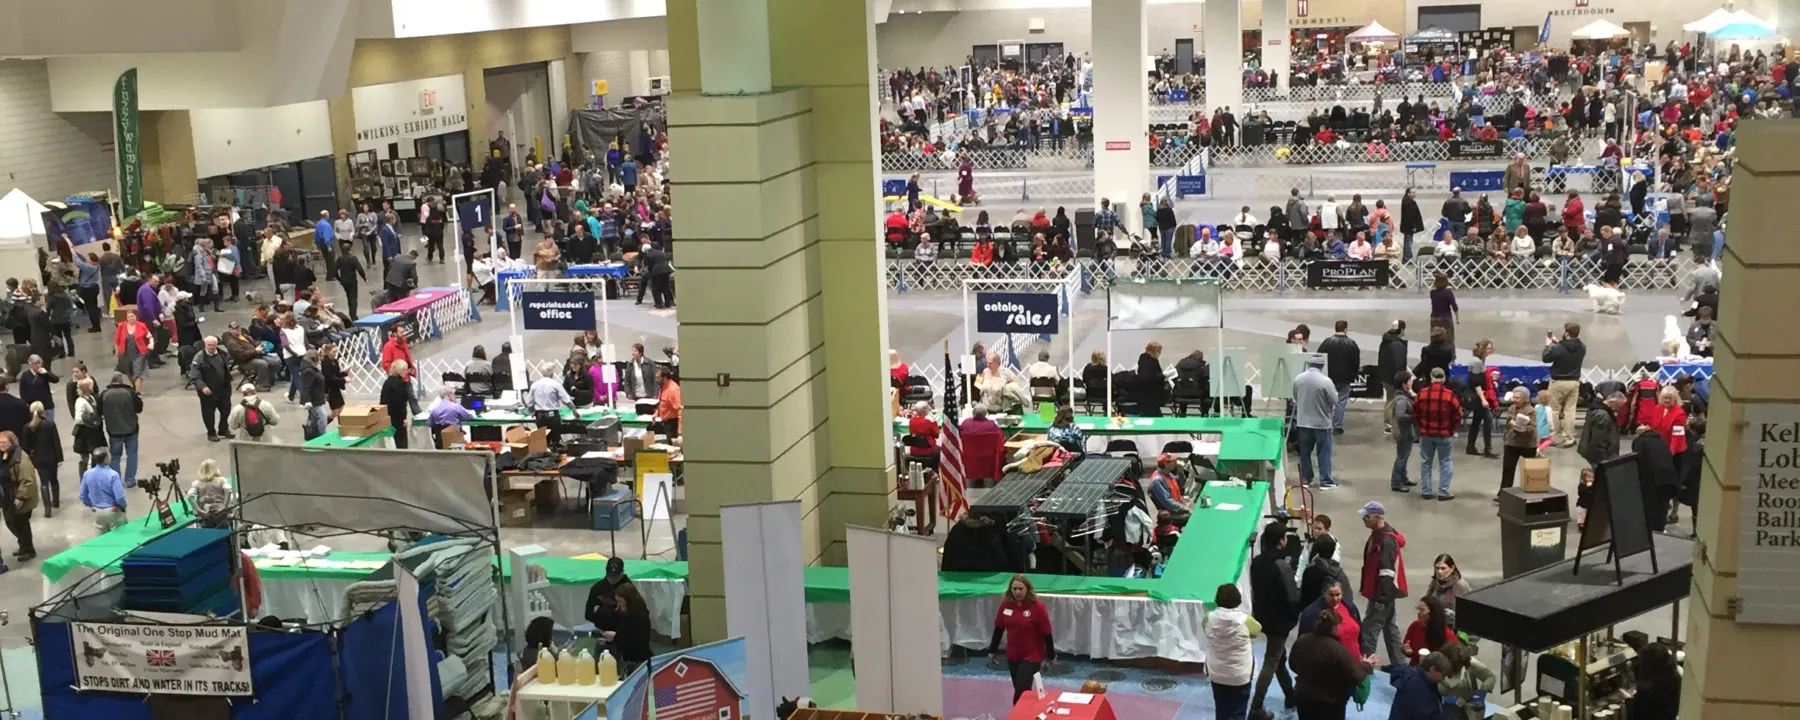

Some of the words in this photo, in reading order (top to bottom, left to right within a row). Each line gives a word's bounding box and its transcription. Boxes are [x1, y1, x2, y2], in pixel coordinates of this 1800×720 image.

[1554, 8, 1609, 16] RESTROOMS
[362, 124, 401, 140] WILKINS
[404, 118, 438, 134] EXHIBIT
[441, 114, 462, 127] HALL
[475, 204, 483, 223] 1
[539, 309, 574, 319] office
[984, 301, 1025, 314] catalog
[1006, 310, 1052, 326] sales
[1758, 473, 1800, 490] Mee
[1757, 492, 1800, 509] Roo
[1756, 511, 1800, 528] Ball
[1756, 530, 1800, 546] Park
[76, 623, 95, 634] The
[98, 625, 140, 638] Original
[143, 627, 165, 638] One
[168, 628, 193, 640] Step
[195, 628, 218, 638] Mud
[221, 629, 242, 639] Mat
[83, 675, 110, 687] STOPS
[111, 677, 130, 688] DIRT
[133, 678, 151, 689] AND
[152, 679, 182, 691] WATER
[184, 680, 194, 691] IN
[195, 680, 209, 691] ITS
[212, 681, 250, 693] TRACKS!
